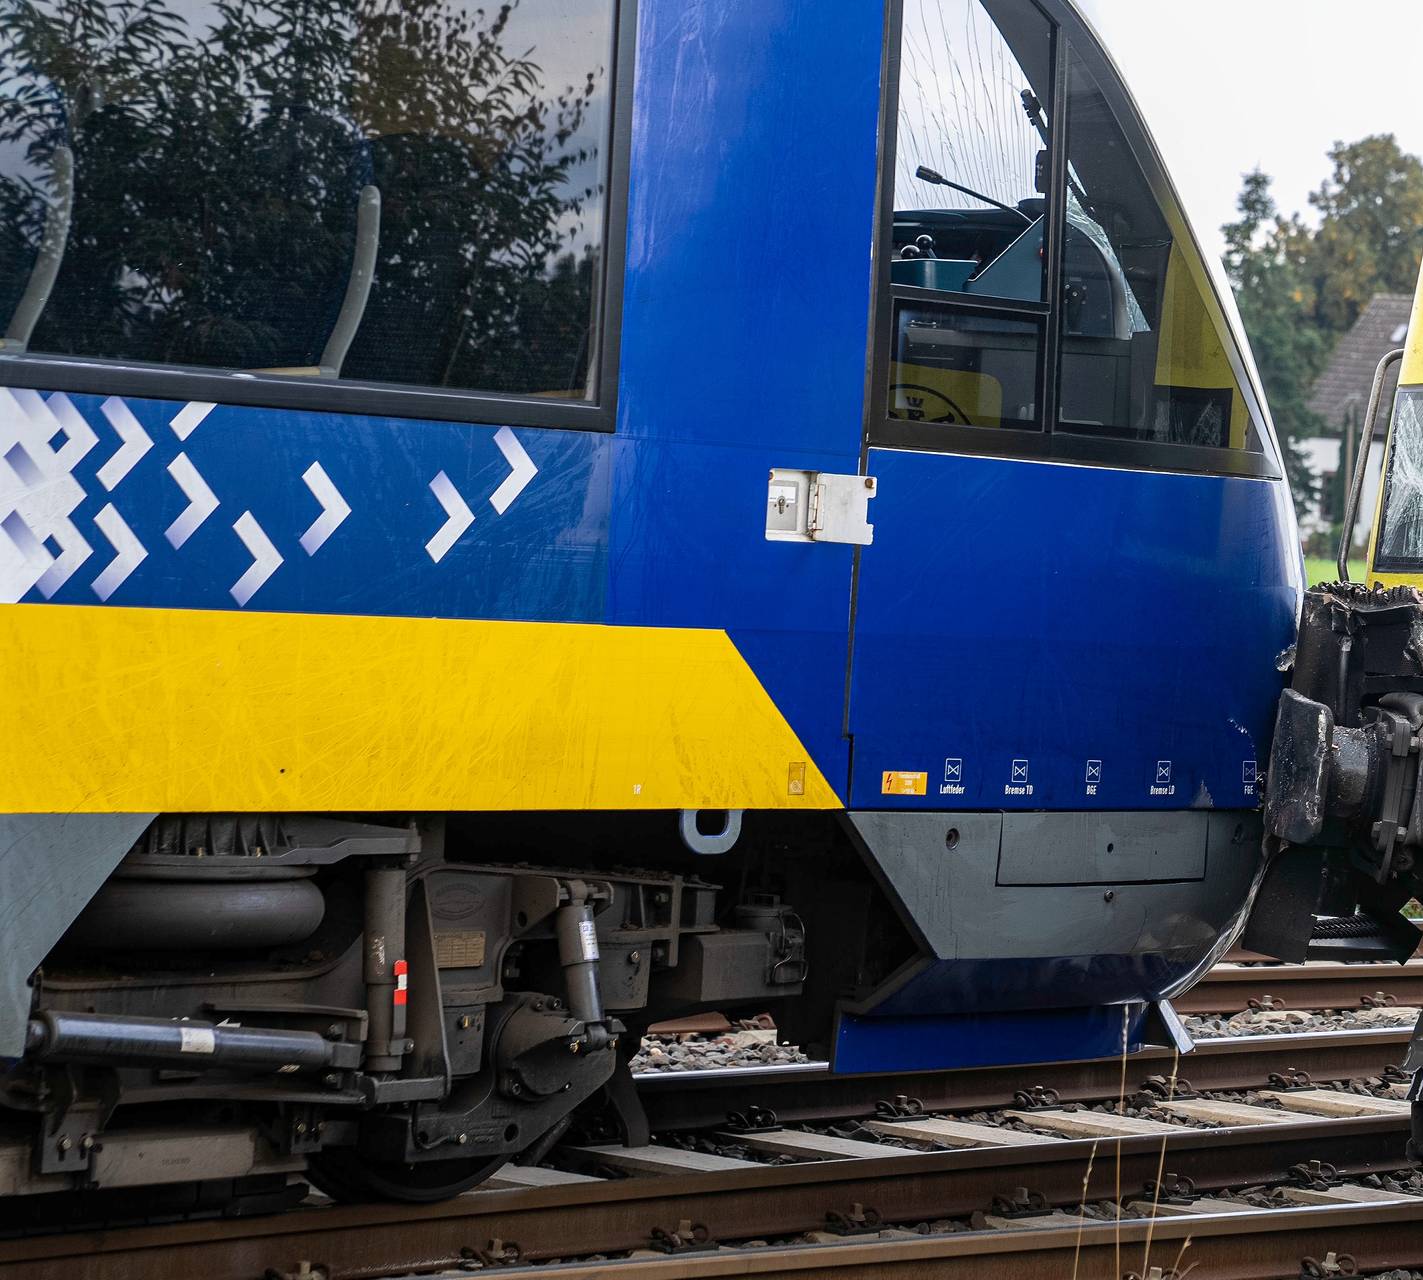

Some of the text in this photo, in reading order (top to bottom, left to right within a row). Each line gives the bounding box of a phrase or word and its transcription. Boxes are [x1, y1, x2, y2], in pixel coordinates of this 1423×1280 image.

[939, 783, 966, 795] Luftfeder
[1004, 784, 1025, 795] Bremse
[1086, 785, 1097, 795] BGE
[1150, 785, 1168, 795] Bremse
